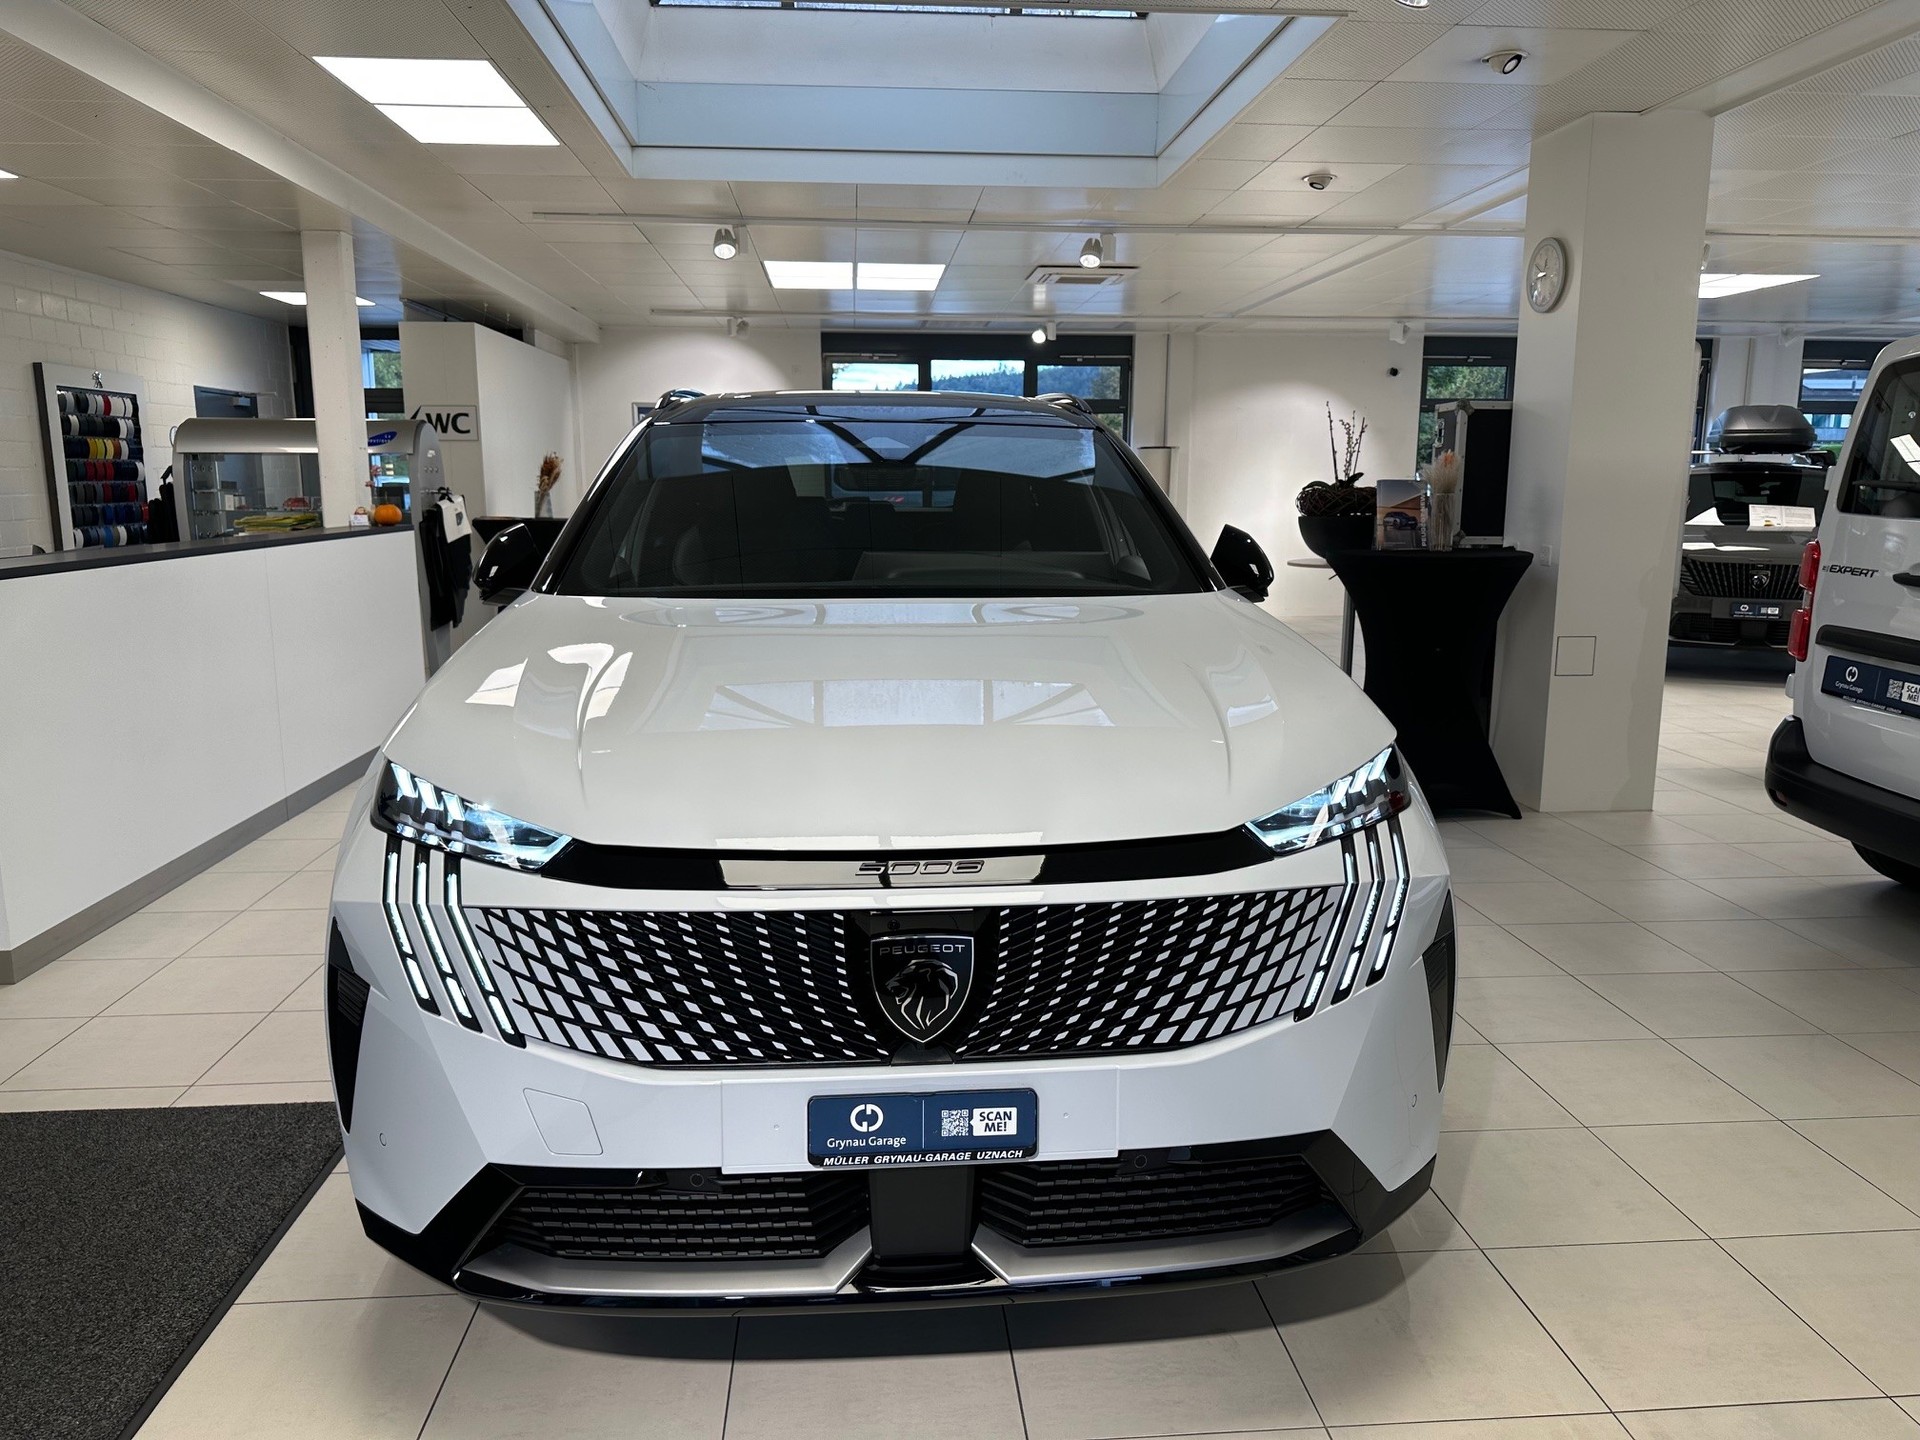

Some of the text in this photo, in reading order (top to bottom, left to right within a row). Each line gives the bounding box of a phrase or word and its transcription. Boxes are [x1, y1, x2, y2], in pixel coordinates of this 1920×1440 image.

[425, 412, 471, 434] WC
[1829, 564, 1879, 578] EXPERT
[1906, 684, 1920, 695] SCA
[855, 859, 985, 876] 5008
[879, 943, 966, 956] PEUGEOT
[979, 1110, 1013, 1123] SCAN
[984, 1121, 1008, 1132] ME!
[826, 1136, 907, 1150] Grynau Garage
[823, 1149, 1023, 1166] MÜLLER GRYNAU-GARAGE UZNACH
